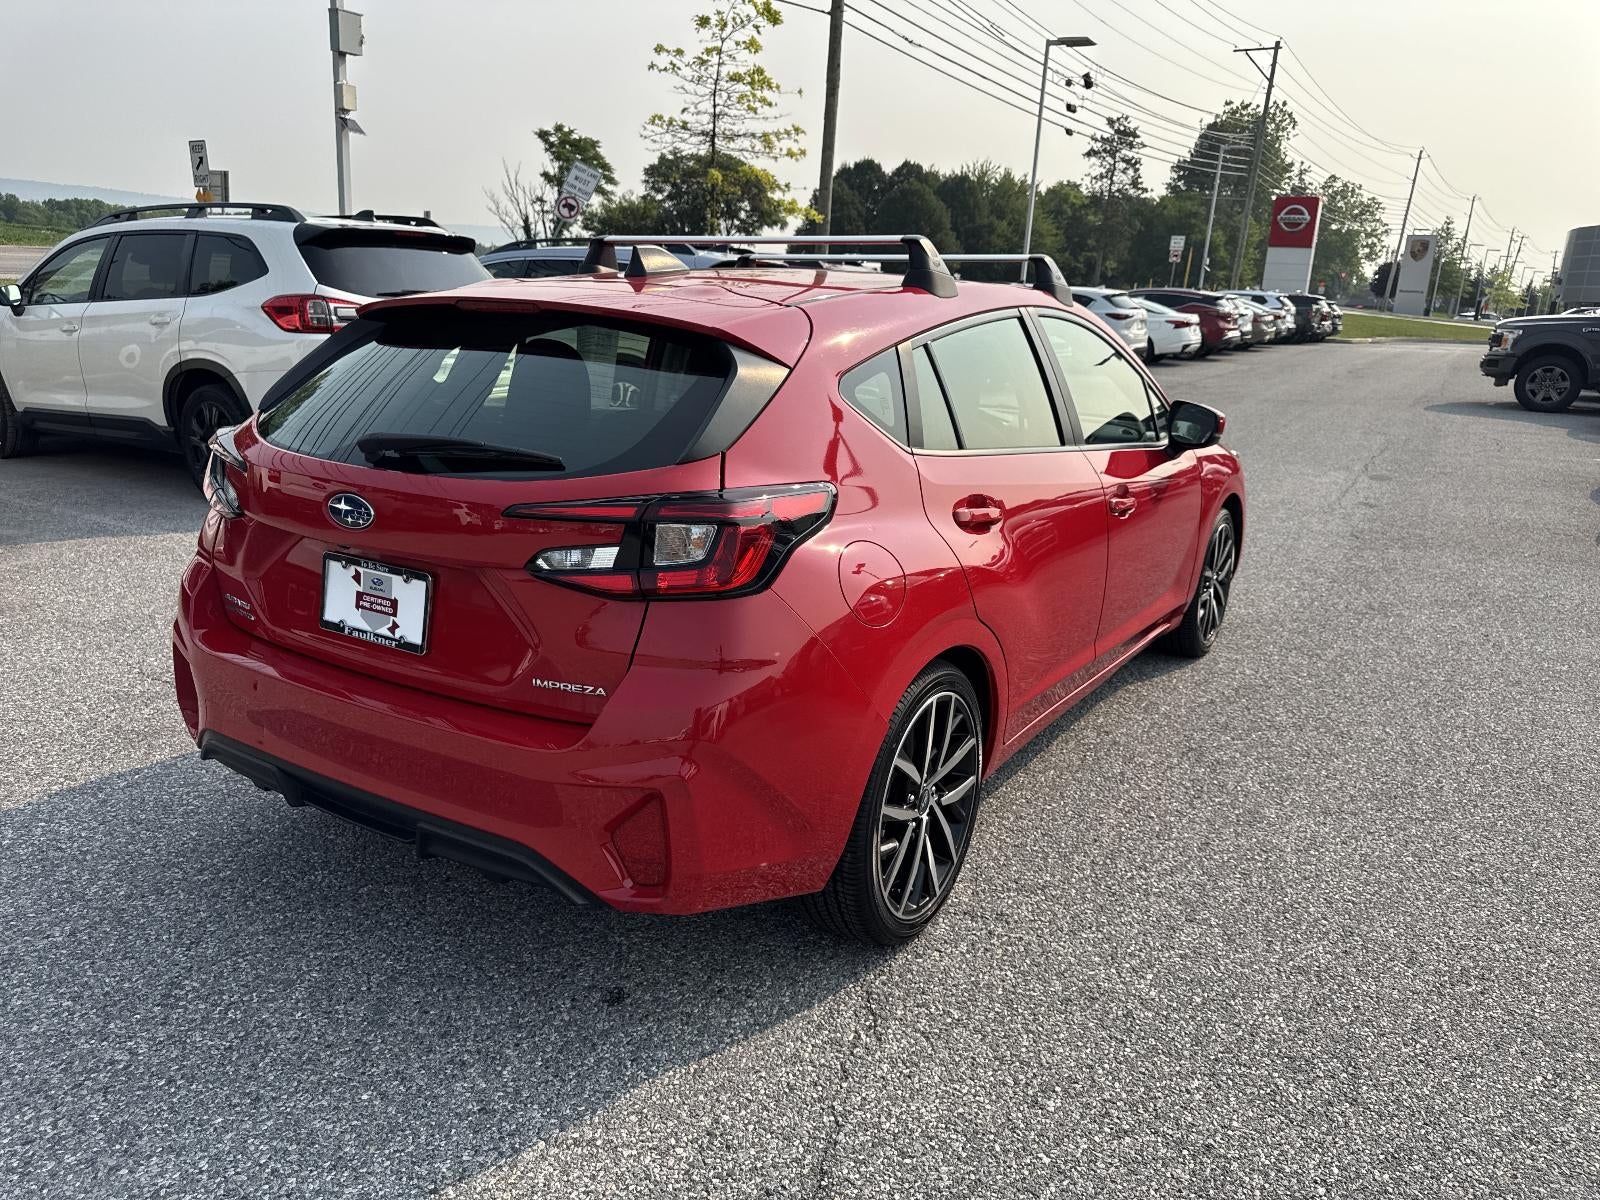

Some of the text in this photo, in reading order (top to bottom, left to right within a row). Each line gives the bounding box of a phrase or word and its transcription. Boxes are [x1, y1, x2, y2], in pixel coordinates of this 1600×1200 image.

[191, 144, 204, 153] KEEP
[574, 175, 590, 187] MUST
[368, 562, 376, 570] Be
[377, 564, 389, 573] Sure
[362, 595, 391, 607] CERTIFIED
[360, 601, 394, 614] PRE-OWNED
[344, 626, 398, 648] Faulkner
[532, 678, 607, 697] IMPREZA
